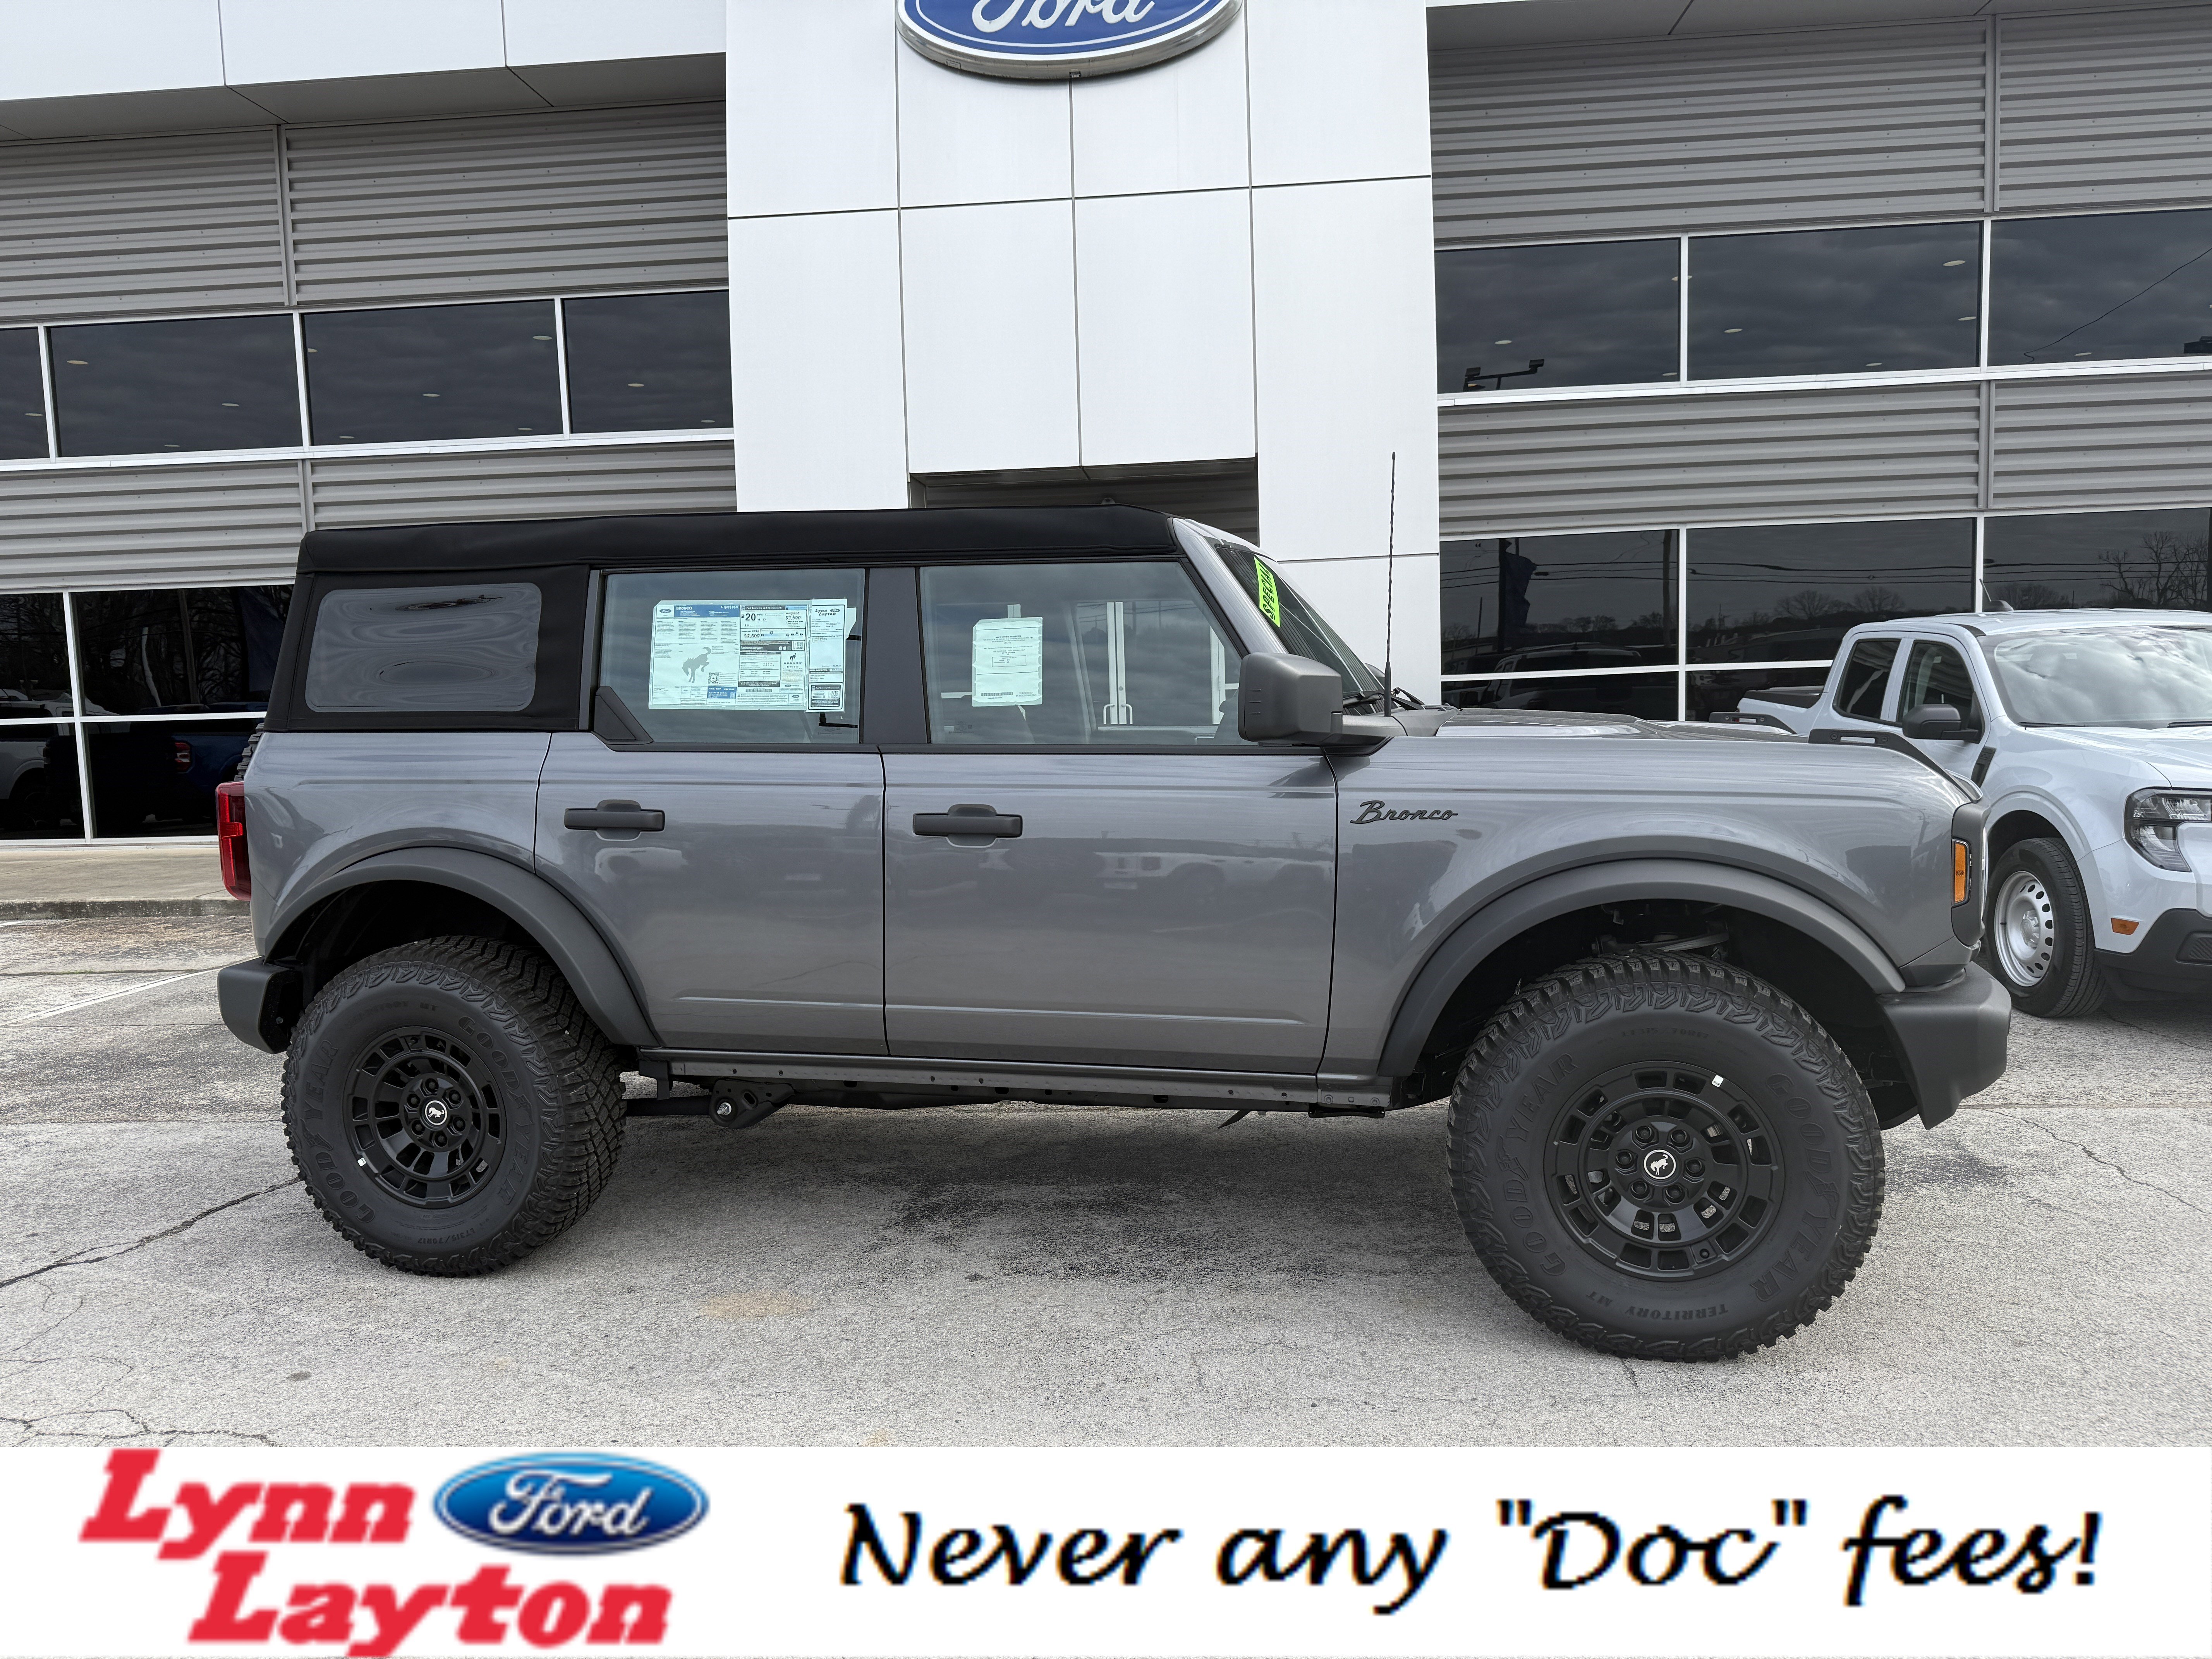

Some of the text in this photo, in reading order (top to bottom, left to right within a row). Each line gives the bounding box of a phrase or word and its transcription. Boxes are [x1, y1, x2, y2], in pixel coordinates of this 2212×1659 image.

[1258, 562, 1275, 620] SPECIAL
[1350, 800, 1458, 824] Bronco
[1585, 1291, 1729, 1321] TERRITORY MT
